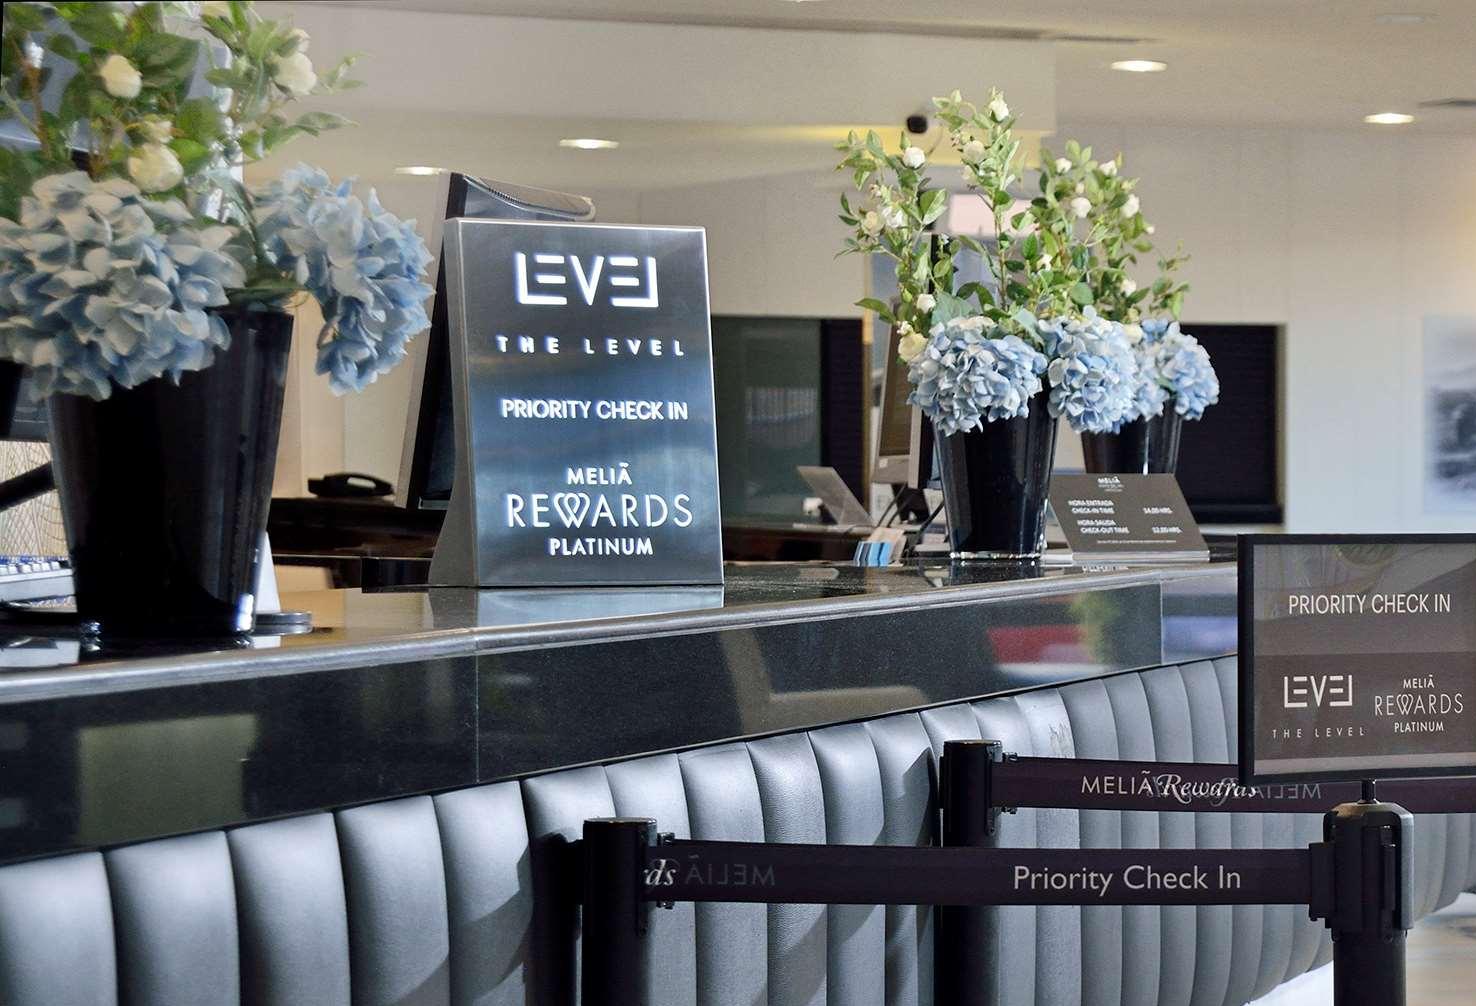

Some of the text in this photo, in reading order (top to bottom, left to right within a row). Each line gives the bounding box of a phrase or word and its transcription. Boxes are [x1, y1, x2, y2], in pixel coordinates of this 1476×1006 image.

[515, 251, 660, 309] LEVEL
[496, 335, 685, 357] THE LEVEL
[501, 399, 689, 421] PRIORITY CHECK IN
[506, 492, 694, 529] REWARDS
[548, 538, 654, 556] PLATINUM
[1288, 593, 1452, 616] PRIORITY CHECK IN
[1283, 674, 1353, 709] LEVEL
[1374, 692, 1464, 717] REWARDS
[1271, 726, 1366, 740] THE LEVEL
[1394, 721, 1445, 734] PLATINUM
[1013, 864, 1241, 897] Priority Check In
